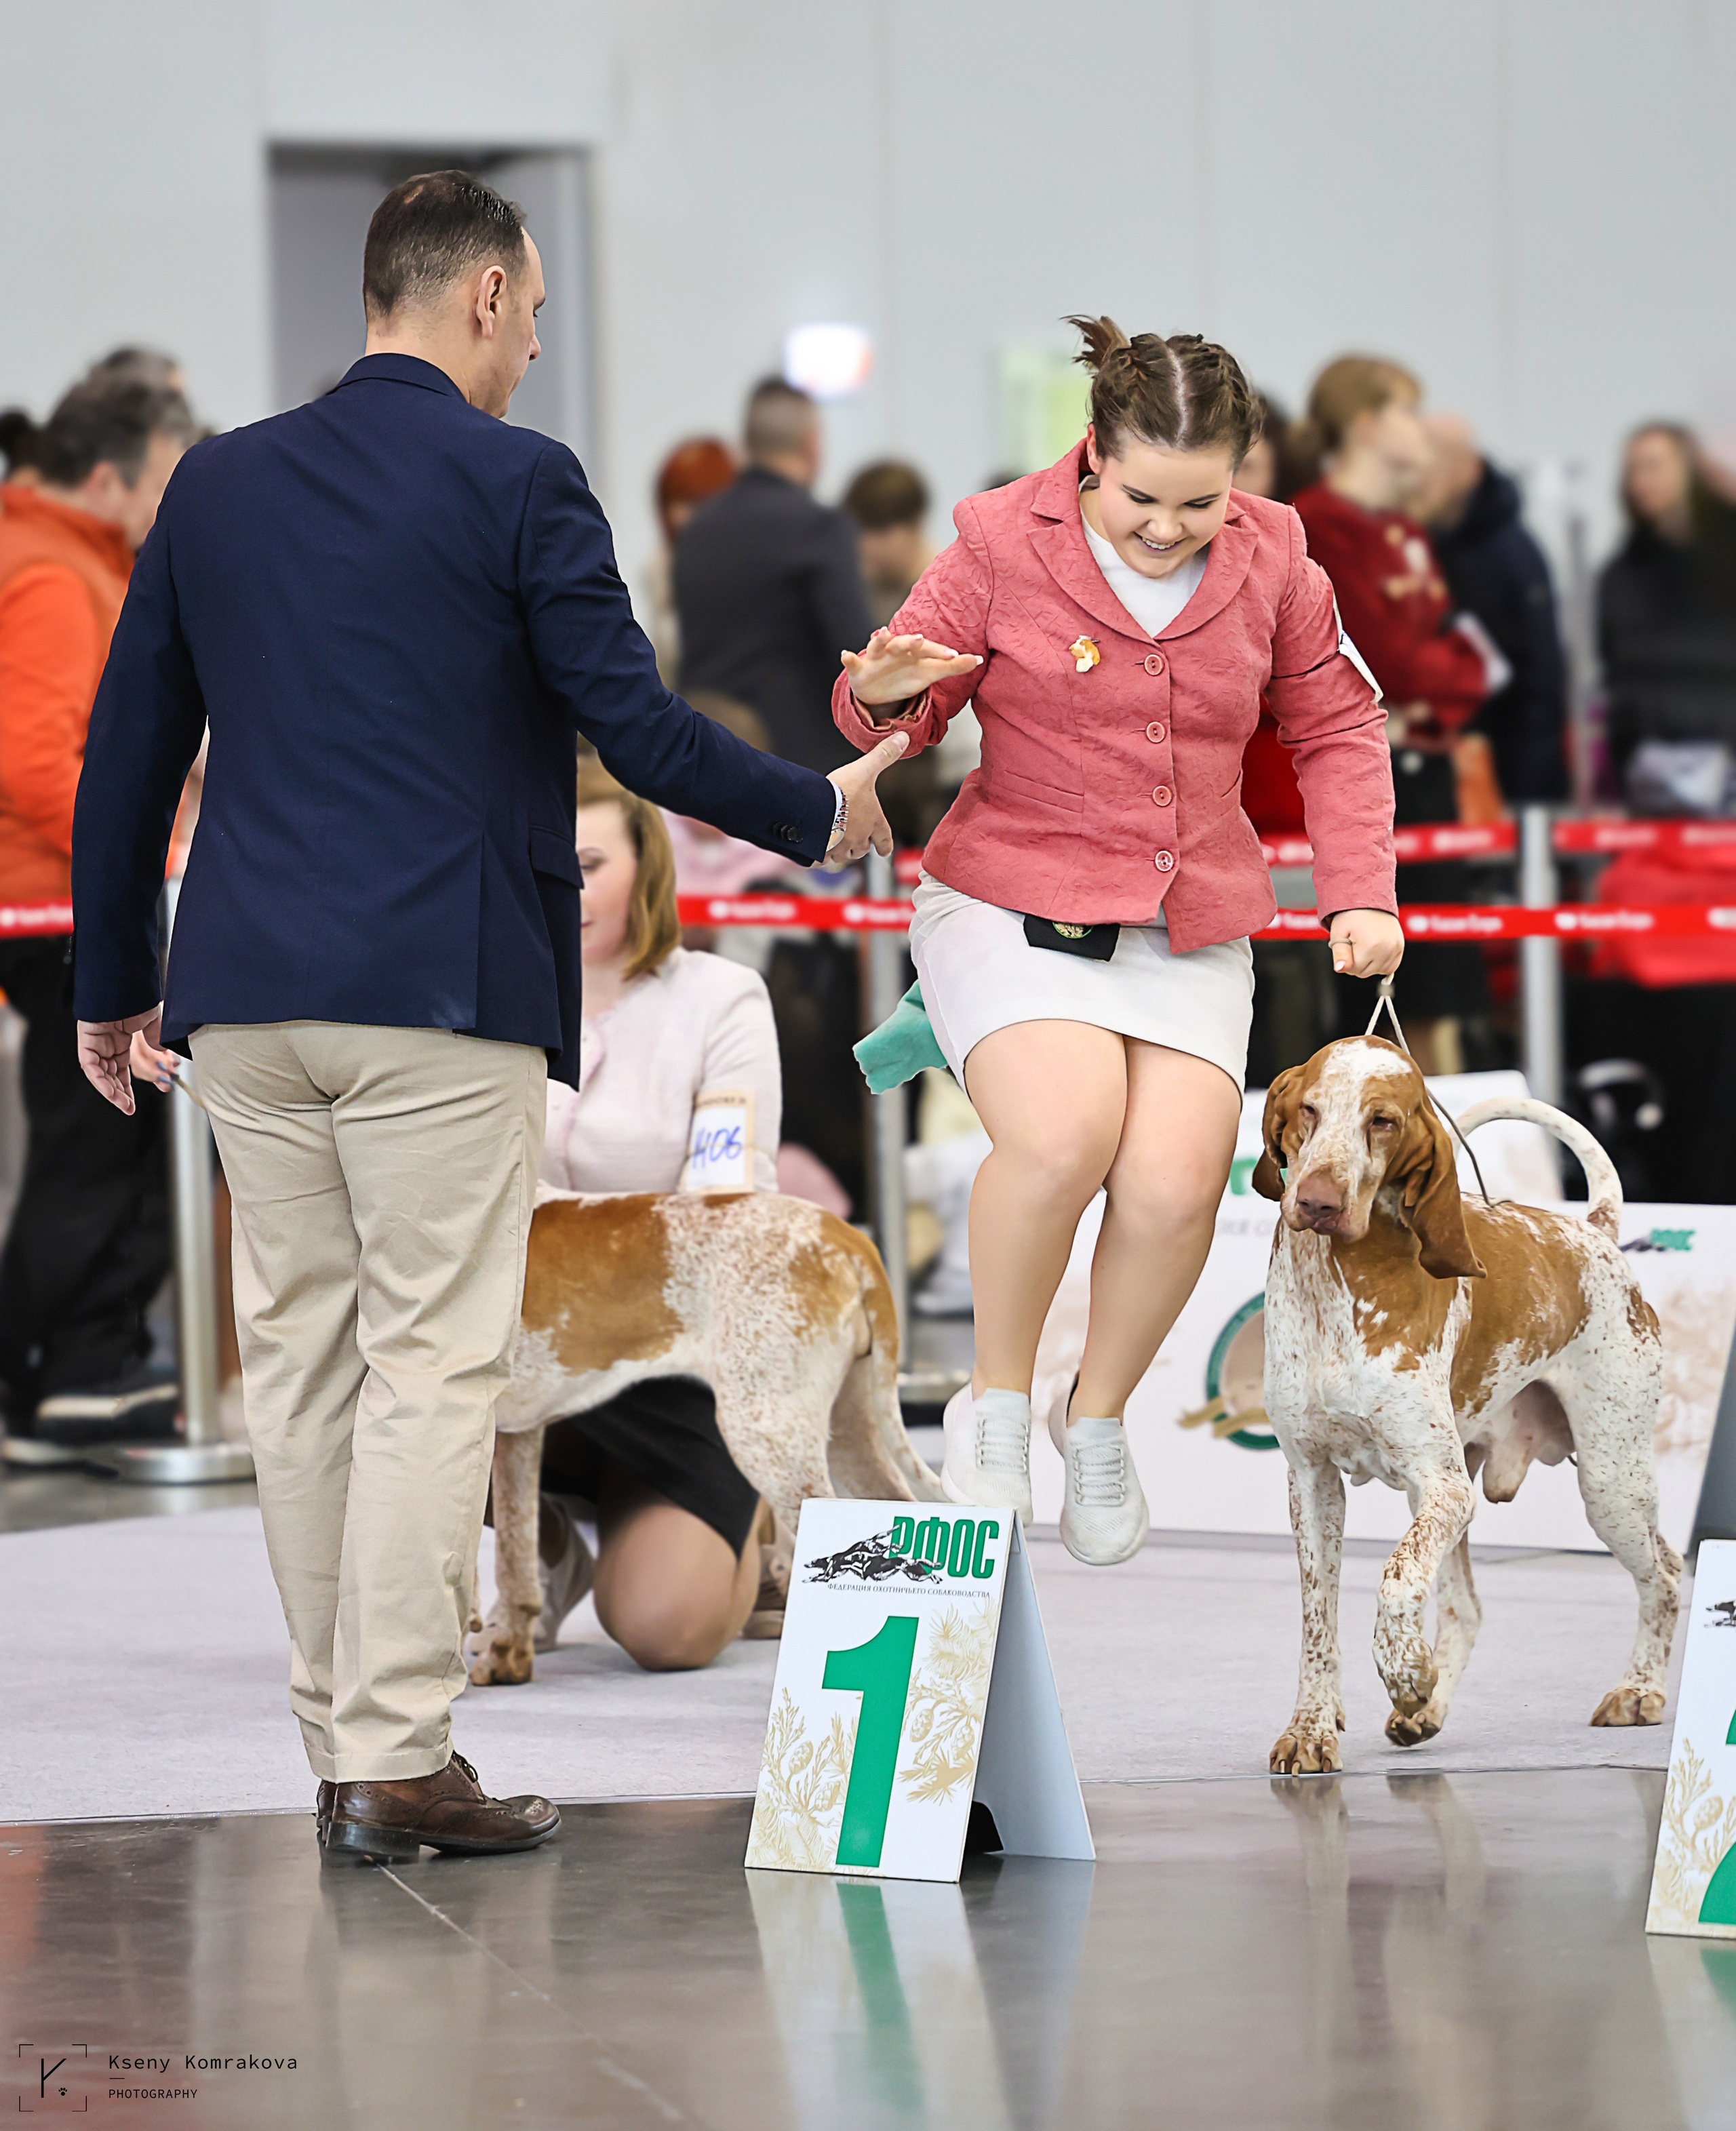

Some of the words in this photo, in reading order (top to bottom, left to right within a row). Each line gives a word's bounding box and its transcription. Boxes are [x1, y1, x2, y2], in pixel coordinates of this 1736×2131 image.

[888, 1516, 1000, 1578] РФОС
[827, 1583, 871, 1593] ФЕДЕРАЦИЯ
[873, 1586, 926, 1595] ОХОТНИЧЬЕГО
[927, 1588, 991, 1598] СОБАКОВОДСТВА
[821, 1615, 920, 1868] 1
